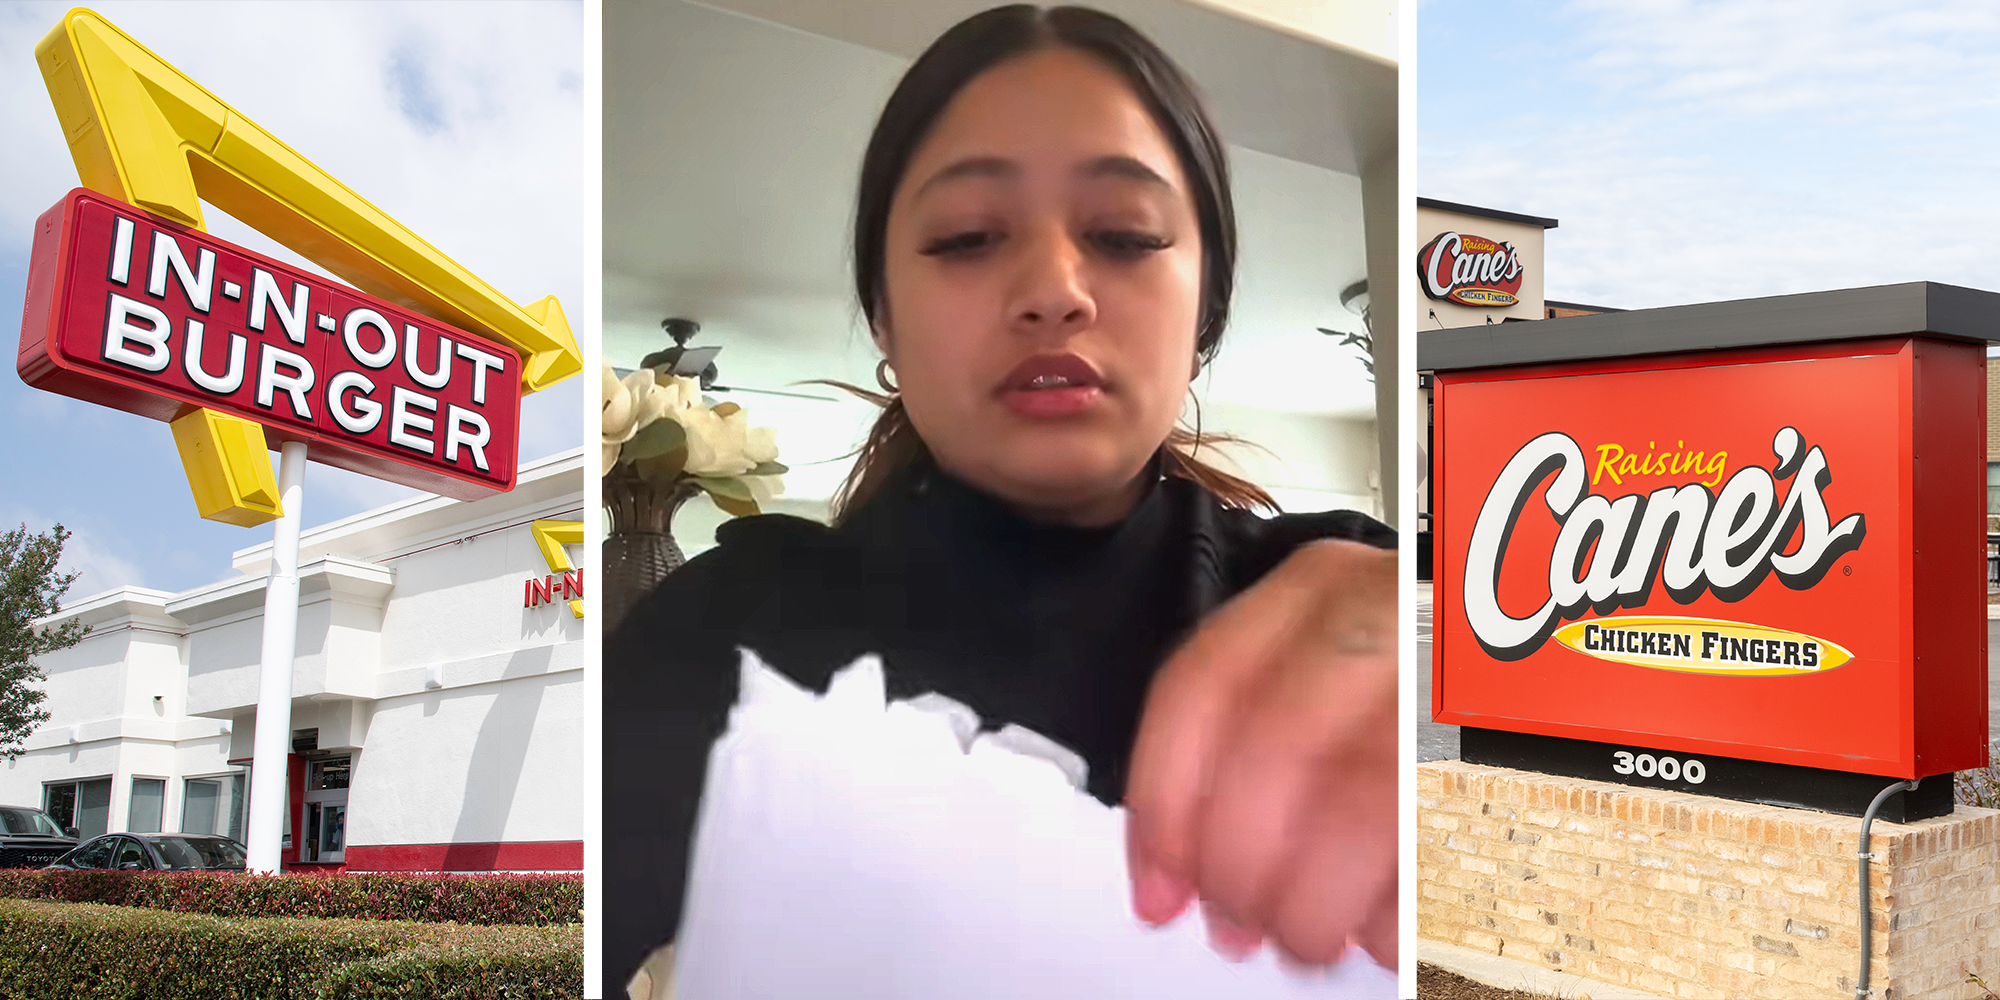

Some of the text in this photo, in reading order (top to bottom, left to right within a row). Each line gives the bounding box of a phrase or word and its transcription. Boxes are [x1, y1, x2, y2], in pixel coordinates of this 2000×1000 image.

[1427, 231, 1523, 299] Cane's
[1462, 238, 1495, 254] Raising
[109, 215, 505, 407] IN-N-OUT
[102, 293, 491, 473] BURGER
[1592, 440, 1728, 488] Raising
[1464, 426, 1867, 662] Cane's
[1584, 623, 1819, 667] CHICKEN FINGERS
[1612, 750, 1707, 785] 3000
